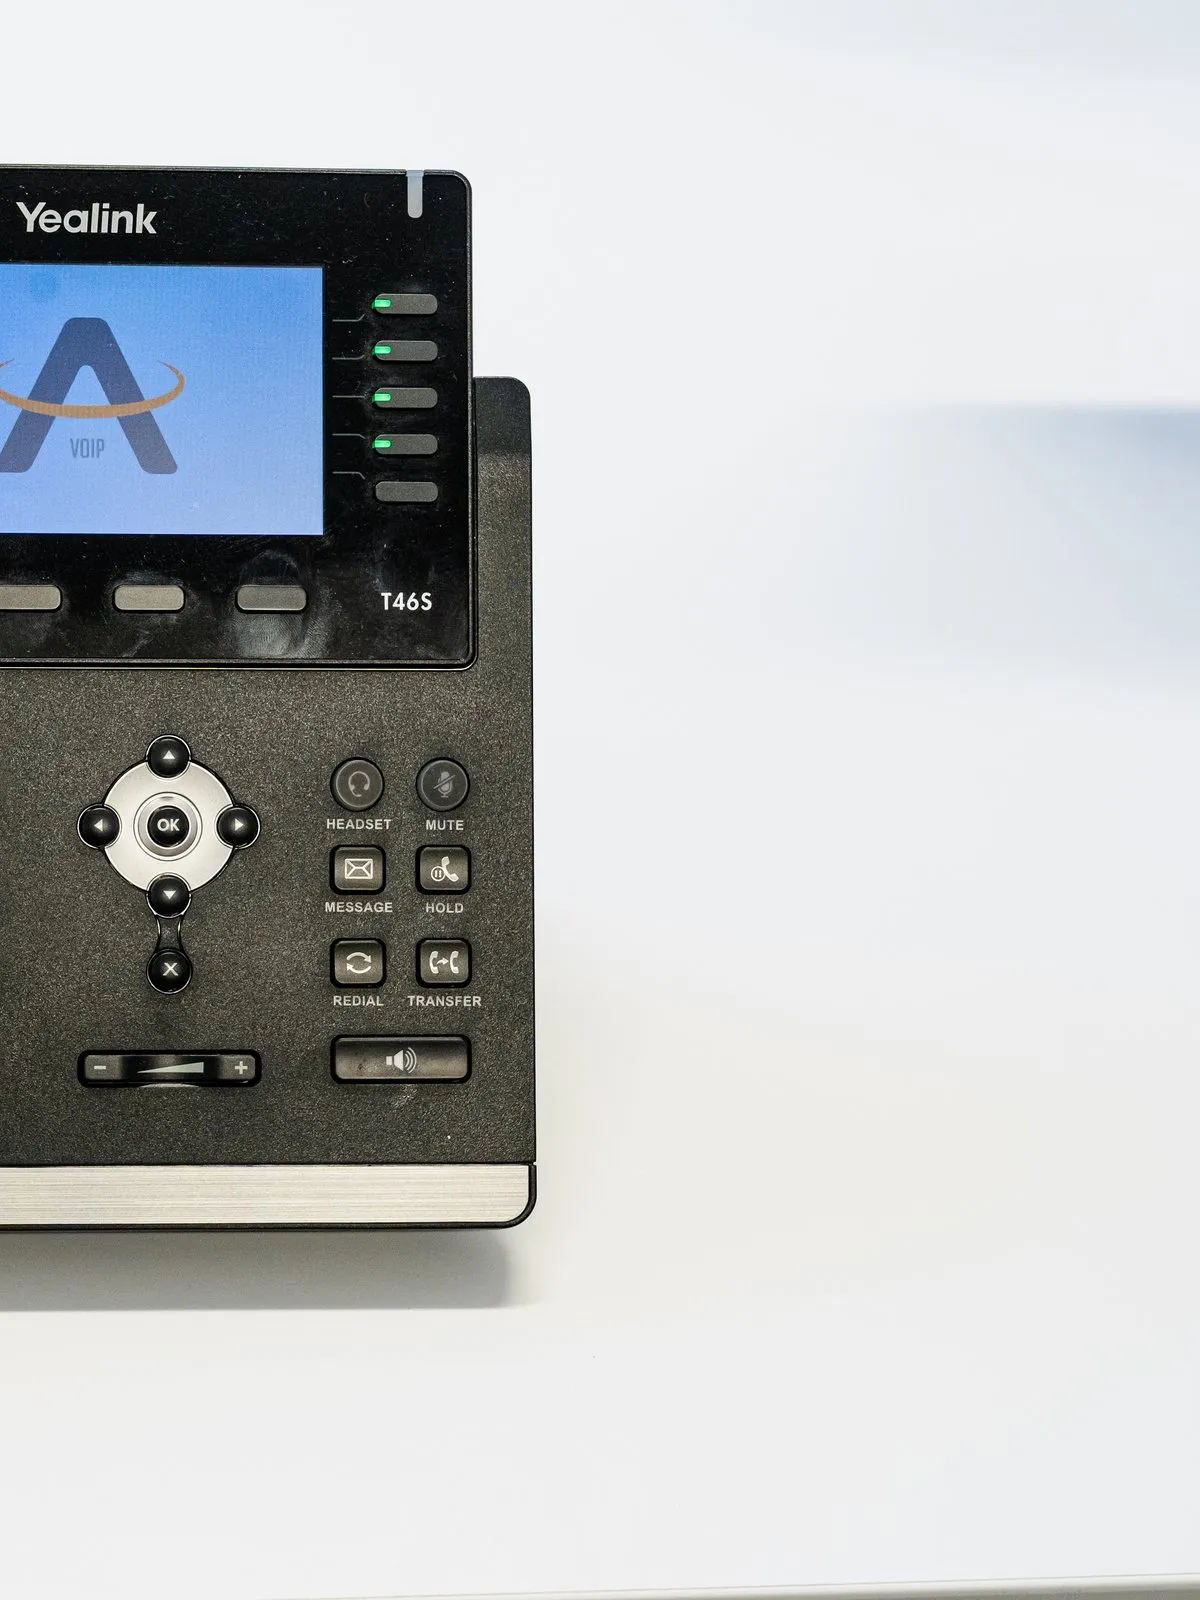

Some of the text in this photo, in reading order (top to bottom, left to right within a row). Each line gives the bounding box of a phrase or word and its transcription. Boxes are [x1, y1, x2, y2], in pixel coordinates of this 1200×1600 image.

[15, 201, 158, 234] Yealink
[69, 437, 106, 460] VOIP
[380, 591, 433, 611] T46S
[156, 818, 180, 832] OK
[326, 818, 392, 830] HEADSET
[425, 819, 464, 831] MUTE
[324, 901, 393, 913] MESSAGE
[425, 902, 464, 914] HOLD
[333, 995, 385, 1007] REDIAL
[407, 995, 482, 1007] TRANSFER
